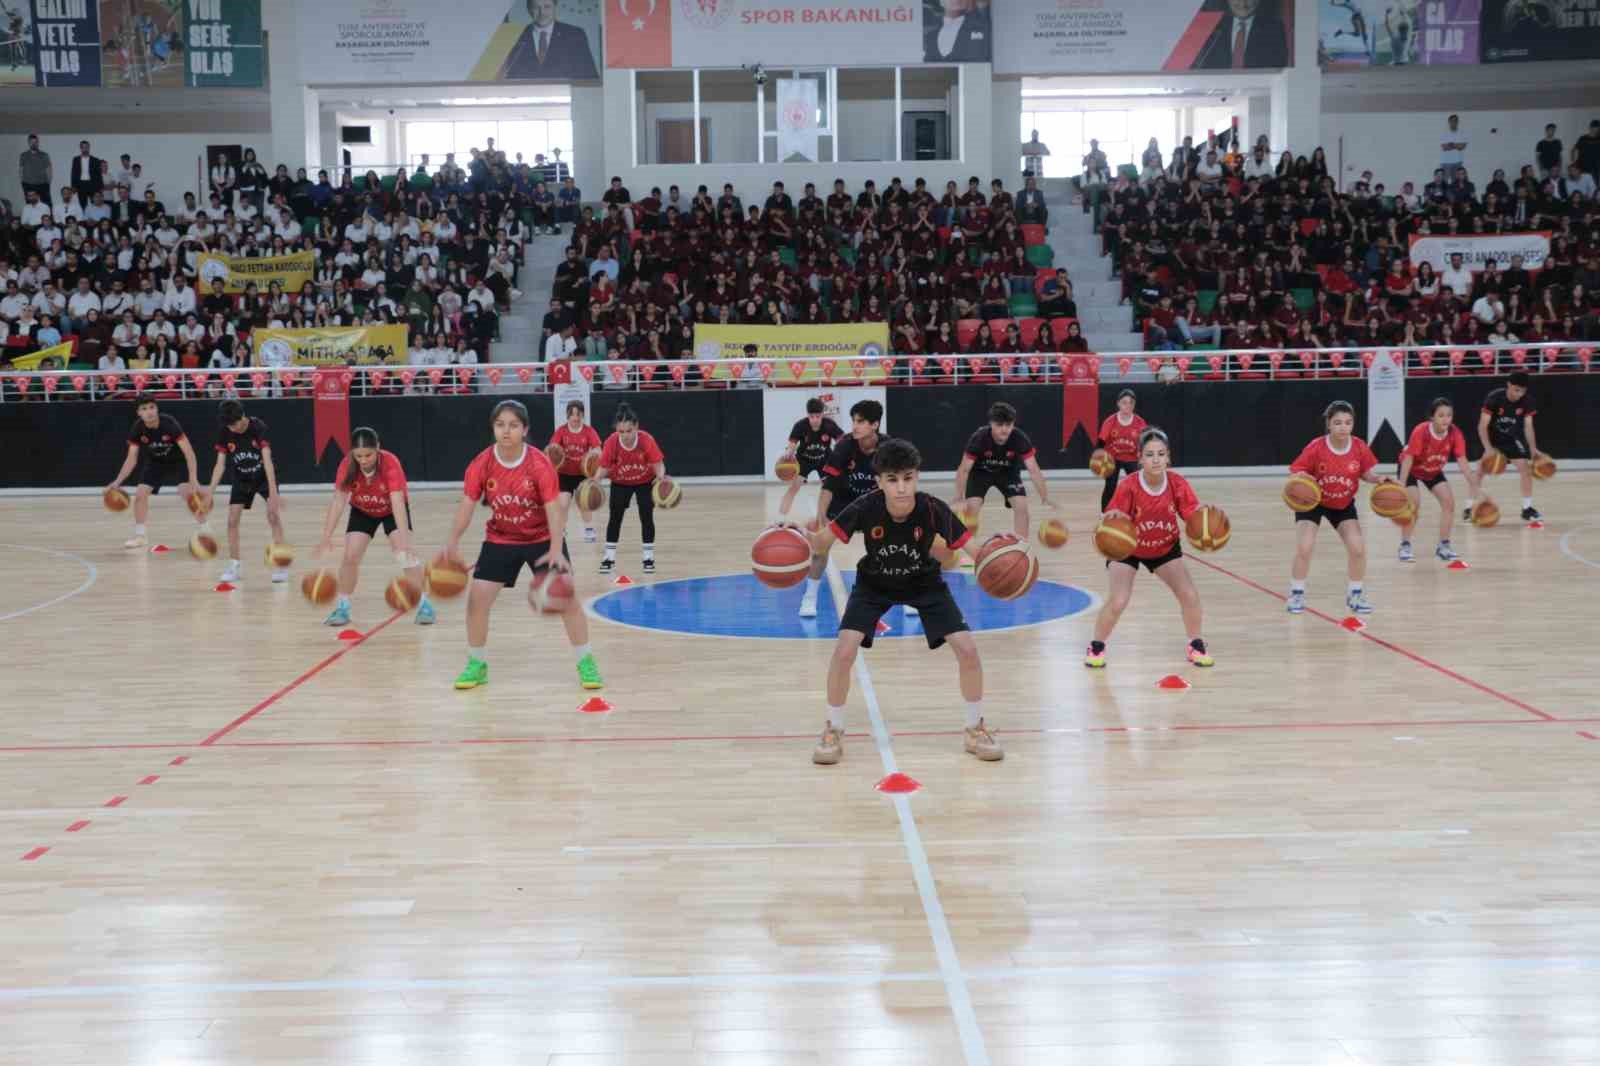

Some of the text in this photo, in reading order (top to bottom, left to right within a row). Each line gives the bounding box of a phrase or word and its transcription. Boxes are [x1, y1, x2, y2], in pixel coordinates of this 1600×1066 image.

[741, 5, 914, 24] SPOR BAKANLIĞI
[37, 23, 78, 46] YETE
[40, 50, 80, 76] ULAŞ
[190, 51, 234, 77] ULAŞ
